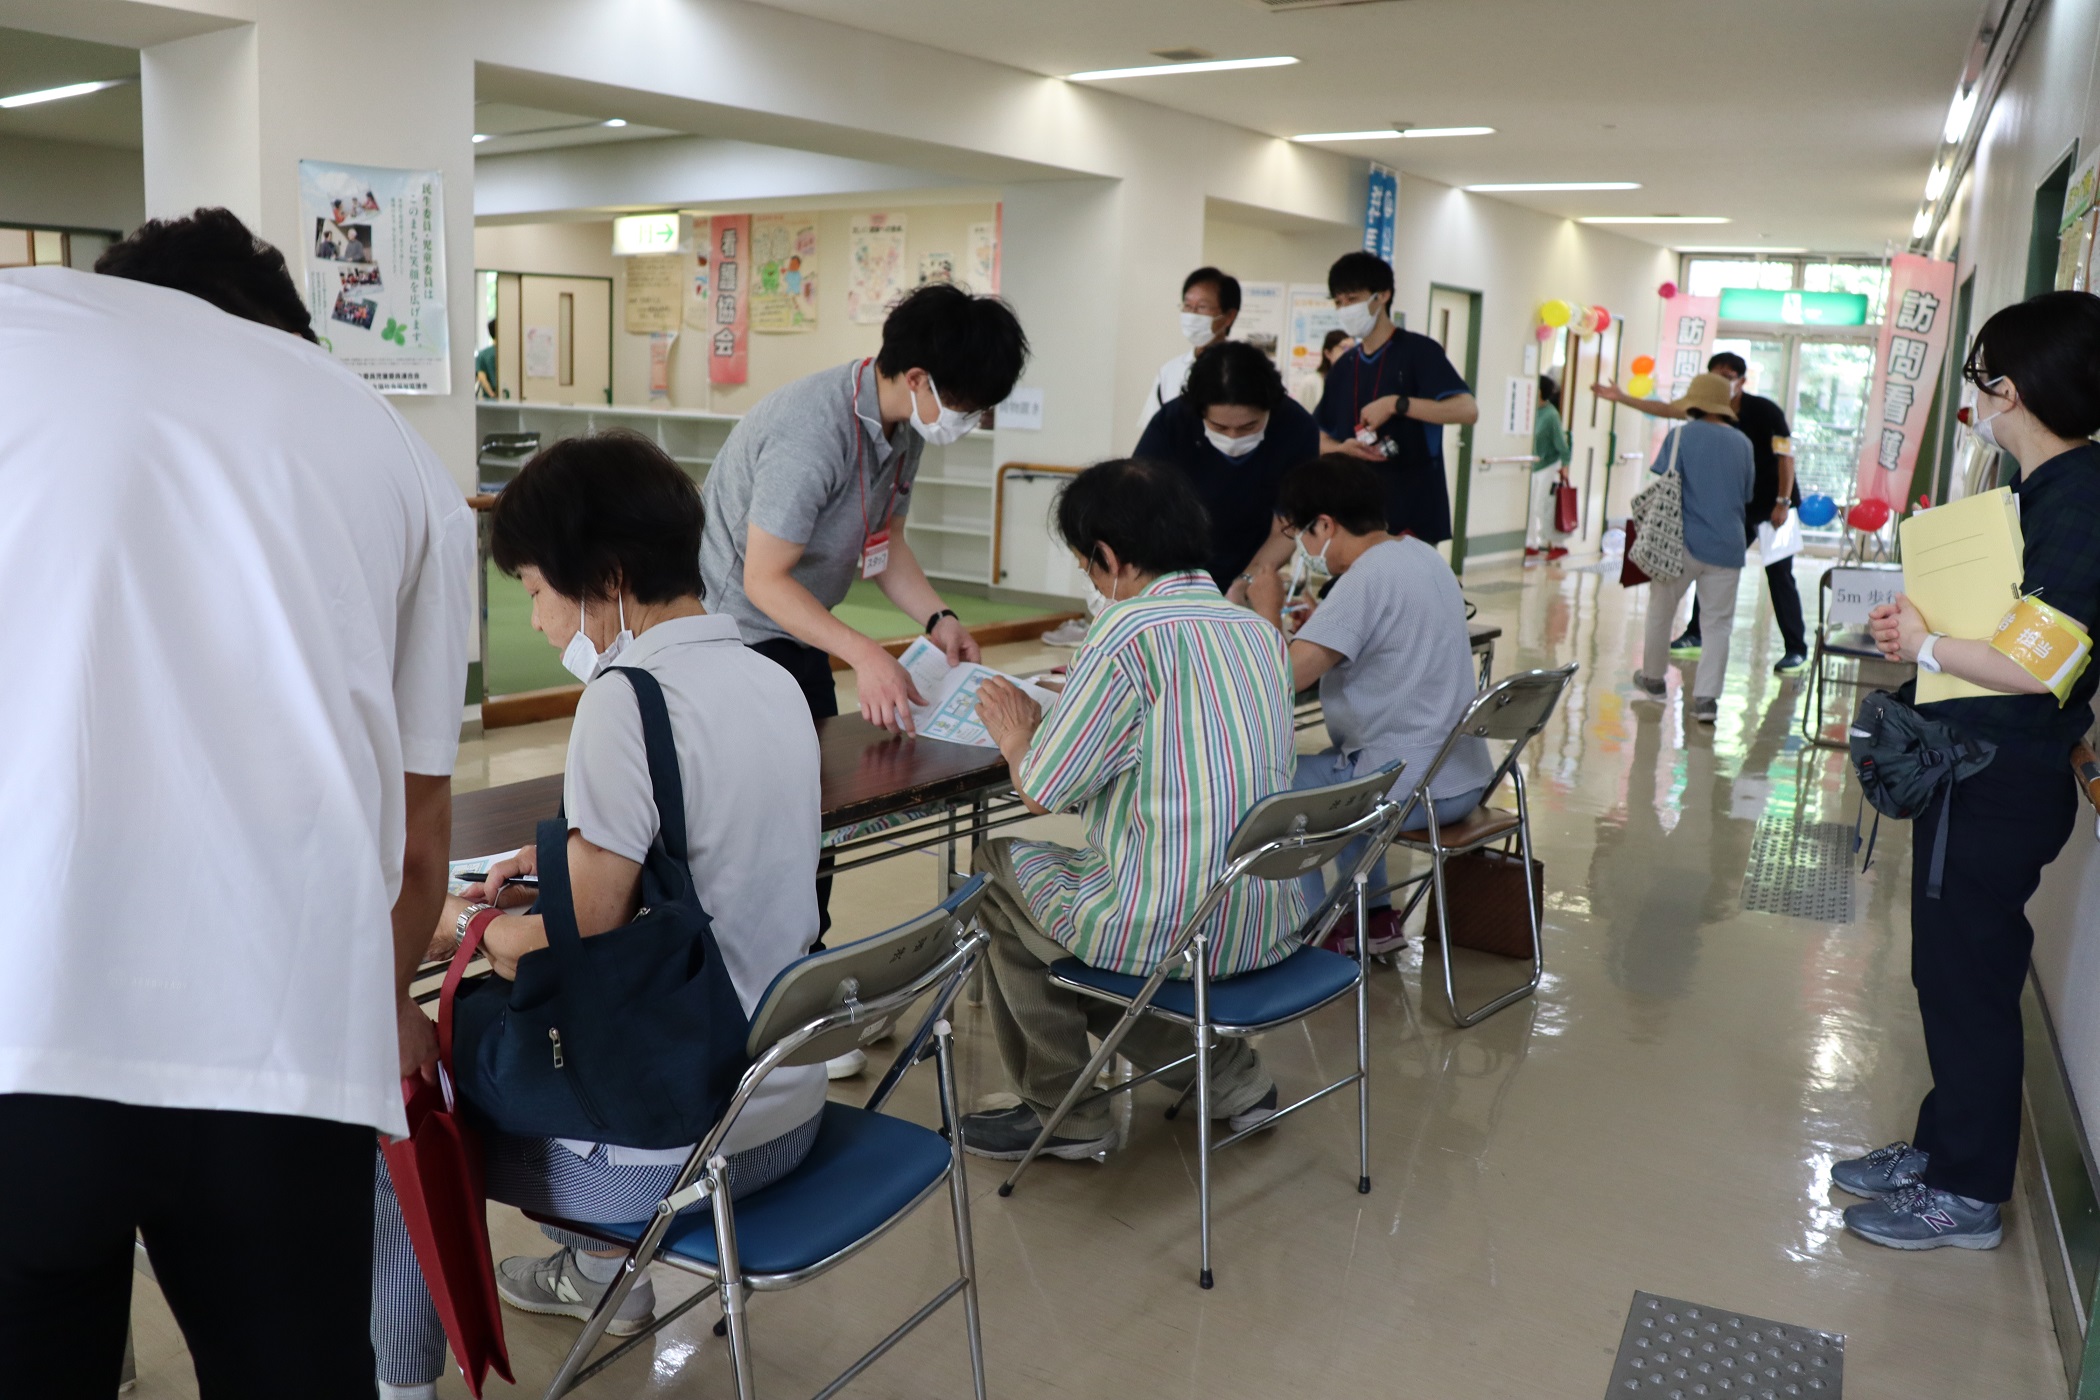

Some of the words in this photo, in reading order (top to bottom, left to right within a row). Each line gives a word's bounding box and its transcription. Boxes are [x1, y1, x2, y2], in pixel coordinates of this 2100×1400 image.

[408, 194, 423, 349] このまちに笑顔を広げます。
[421, 183, 434, 300] 民生委員・児童委員は
[713, 228, 738, 357] 看護協会
[1878, 288, 1940, 471] 訪問看護
[1837, 588, 1861, 604] 5m
